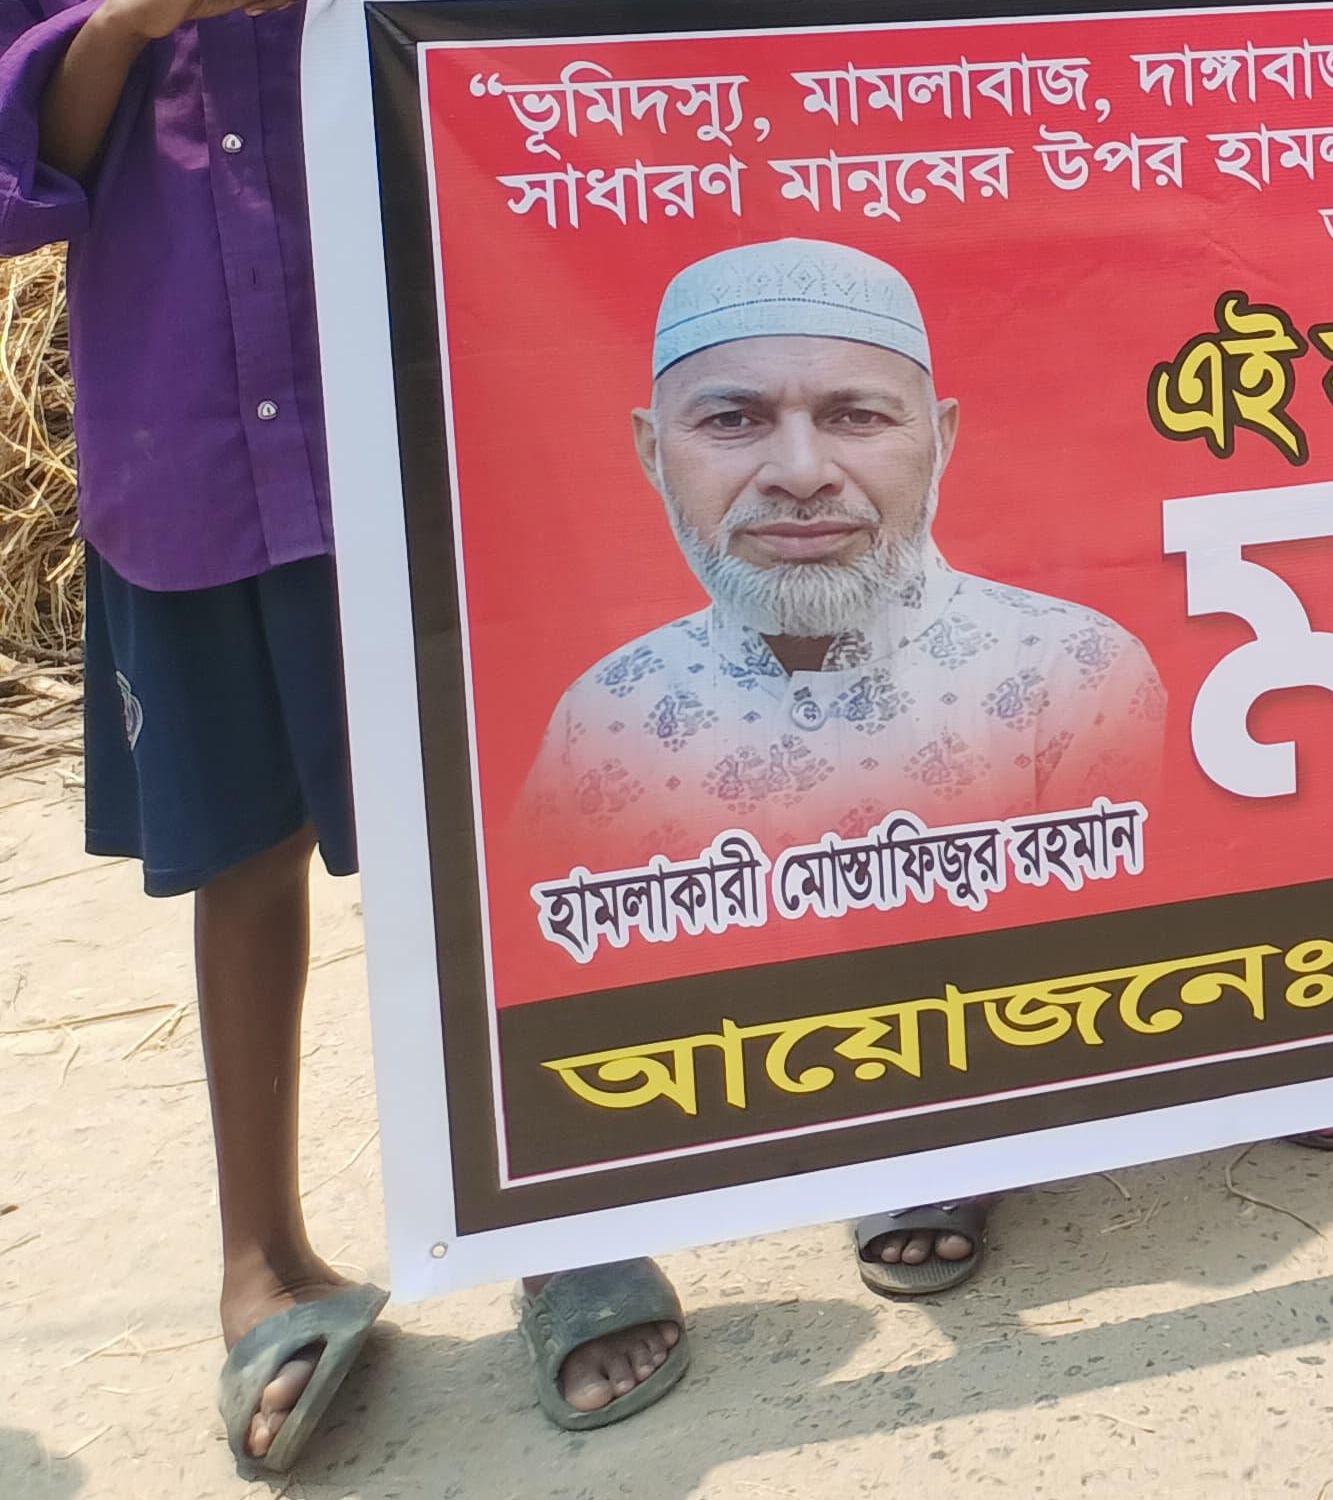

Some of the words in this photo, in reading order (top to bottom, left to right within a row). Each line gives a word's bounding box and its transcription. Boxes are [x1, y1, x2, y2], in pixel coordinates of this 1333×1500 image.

[469, 59, 771, 155] “ভূমিদস্যু,
[791, 55, 1111, 123] মামলাবাজ,
[495, 153, 748, 230] সাধারণ
[767, 145, 1013, 223] মানুষের
[1034, 123, 1188, 192] উপর
[1148, 290, 1309, 463] এই
[536, 832, 764, 955] হামলাকারী
[779, 815, 1002, 904] মোস্তাফিজুর
[1014, 801, 1146, 882] রহমান
